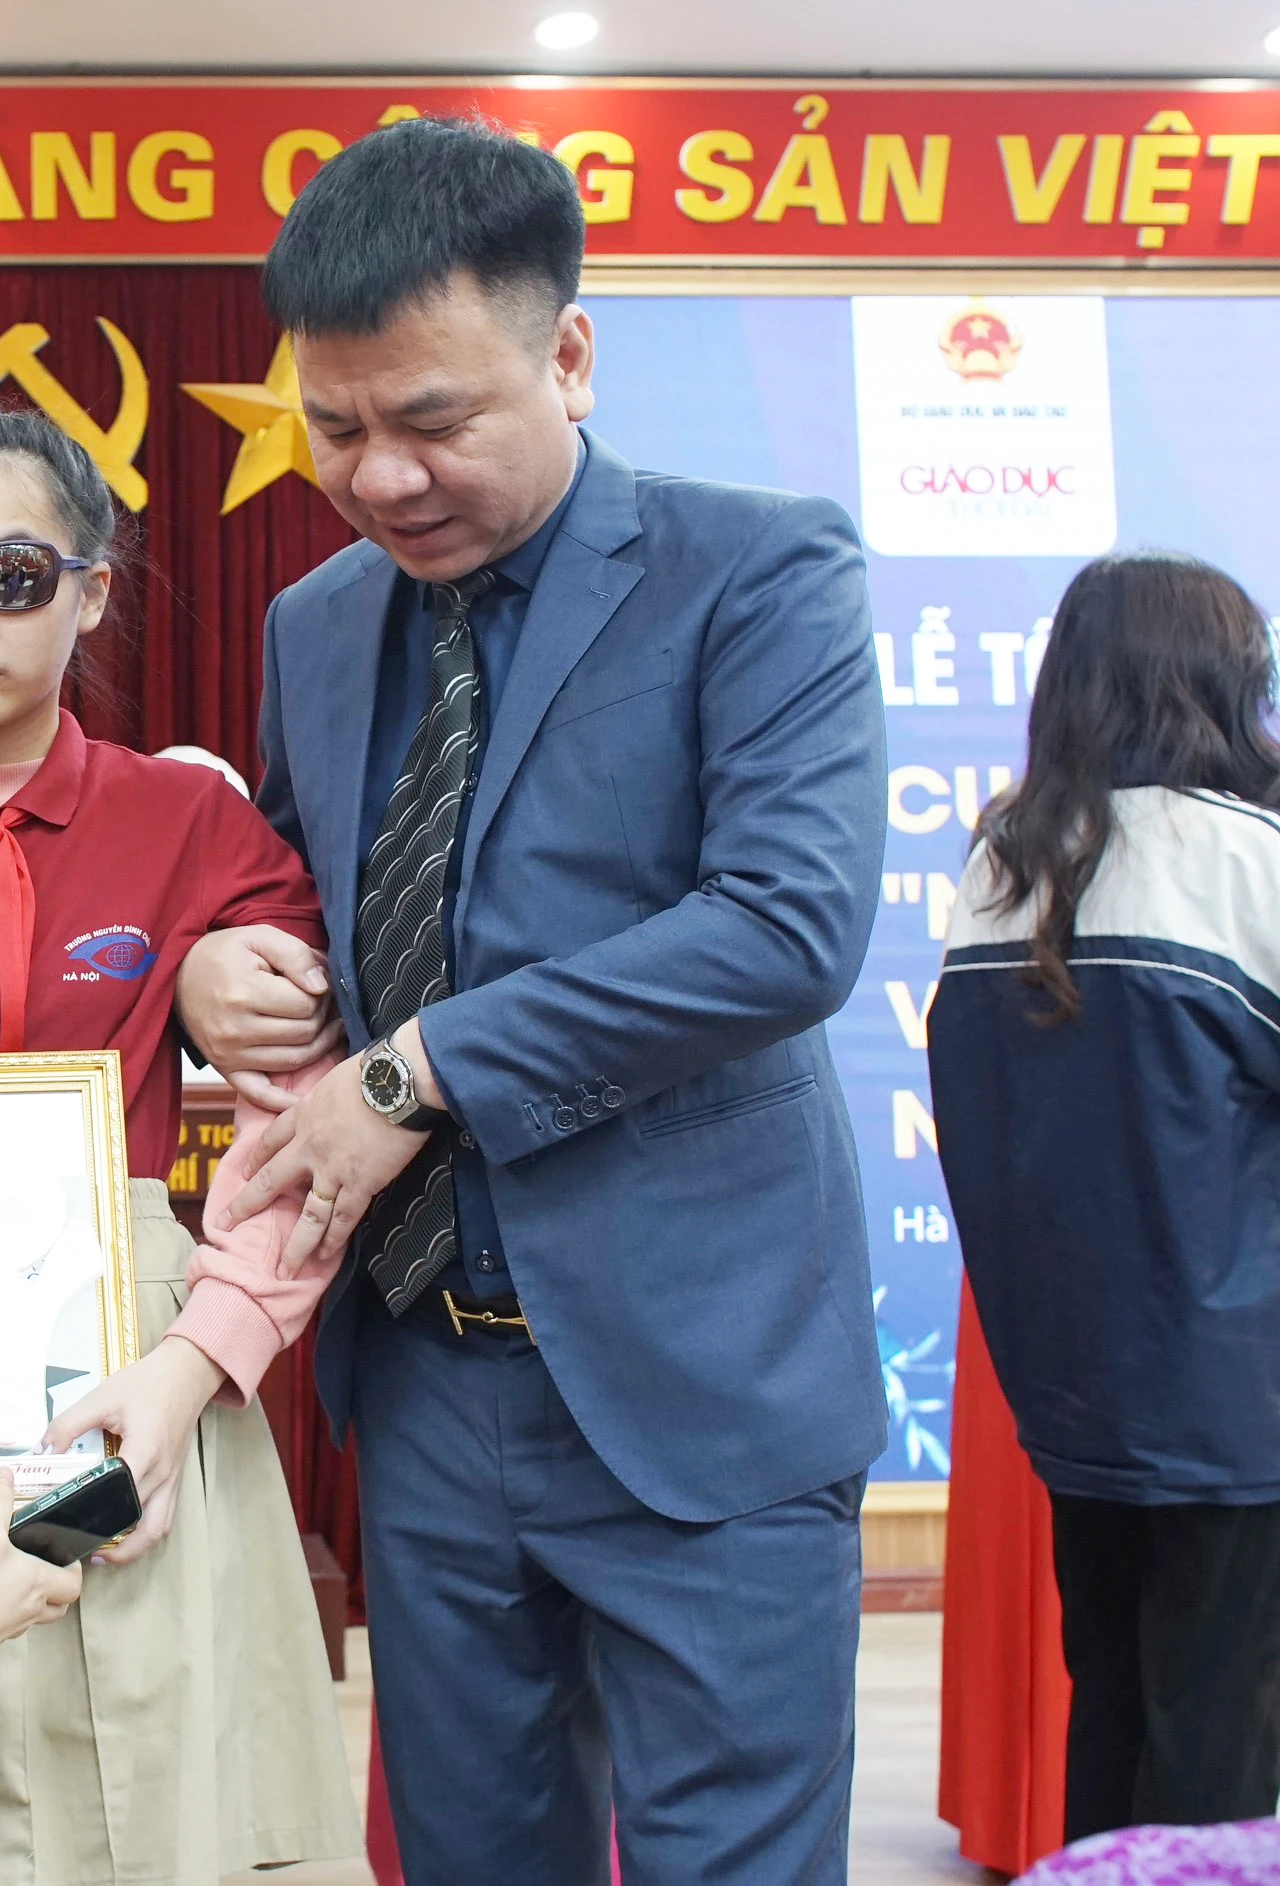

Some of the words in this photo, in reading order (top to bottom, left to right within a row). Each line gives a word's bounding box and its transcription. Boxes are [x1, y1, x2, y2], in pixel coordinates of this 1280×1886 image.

[261, 104, 635, 224] CG
[674, 94, 950, 224] SẢN
[997, 110, 1280, 249] VIỆT
[873, 606, 959, 706] LỄ
[62, 971, 78, 981] HÀ
[80, 971, 100, 982] NỘI
[197, 1123, 236, 1149] TỊC
[893, 1204, 949, 1243] Hà
